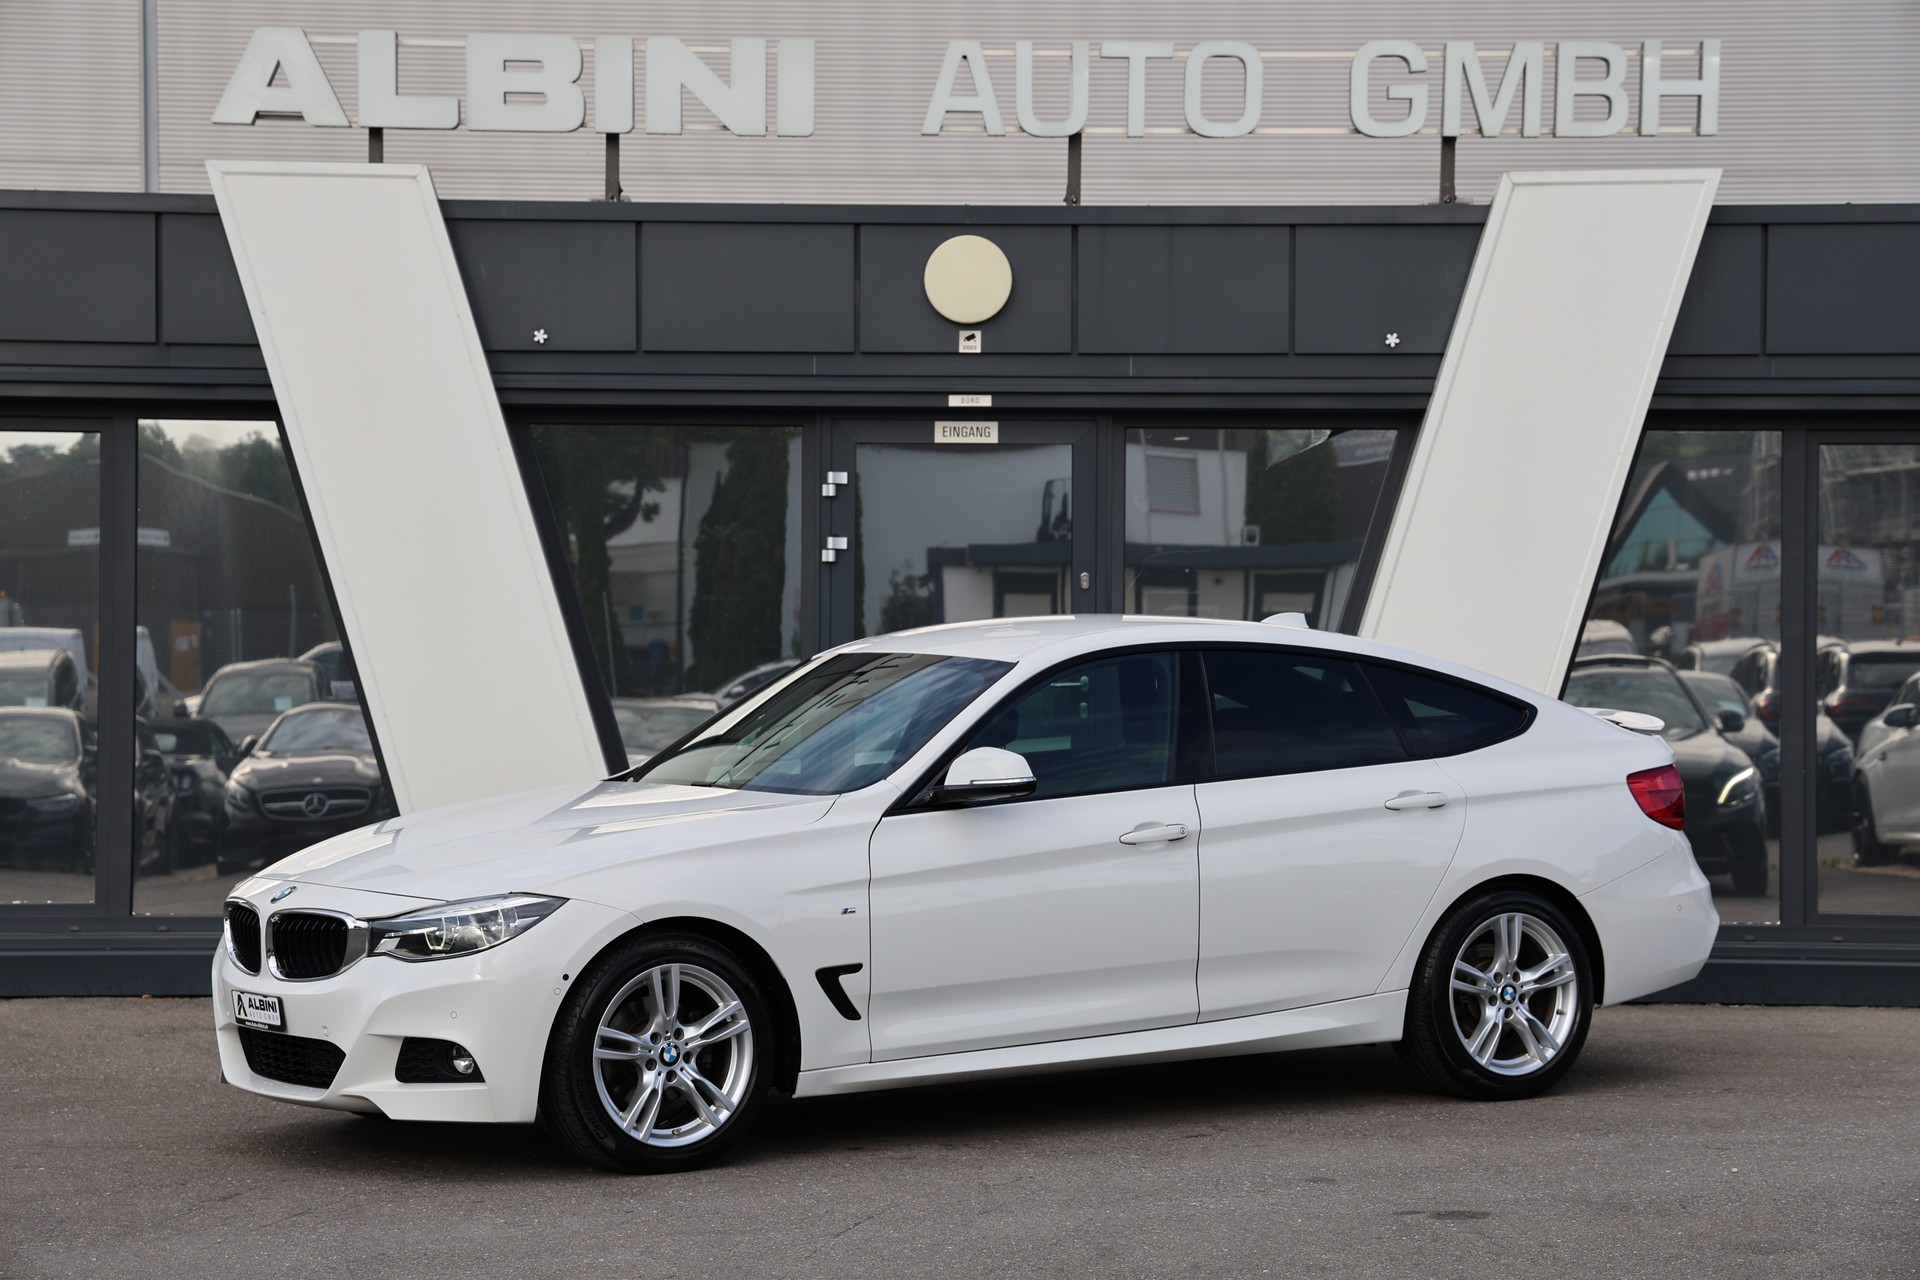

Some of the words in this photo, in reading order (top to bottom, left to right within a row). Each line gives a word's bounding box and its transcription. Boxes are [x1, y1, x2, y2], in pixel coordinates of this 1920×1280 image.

[211, 27, 815, 137] ALBINI
[921, 39, 1263, 138] AUTO
[1349, 38, 1722, 138] GMBH
[942, 425, 991, 438] EINGANG
[248, 997, 278, 1013] ALBINI
